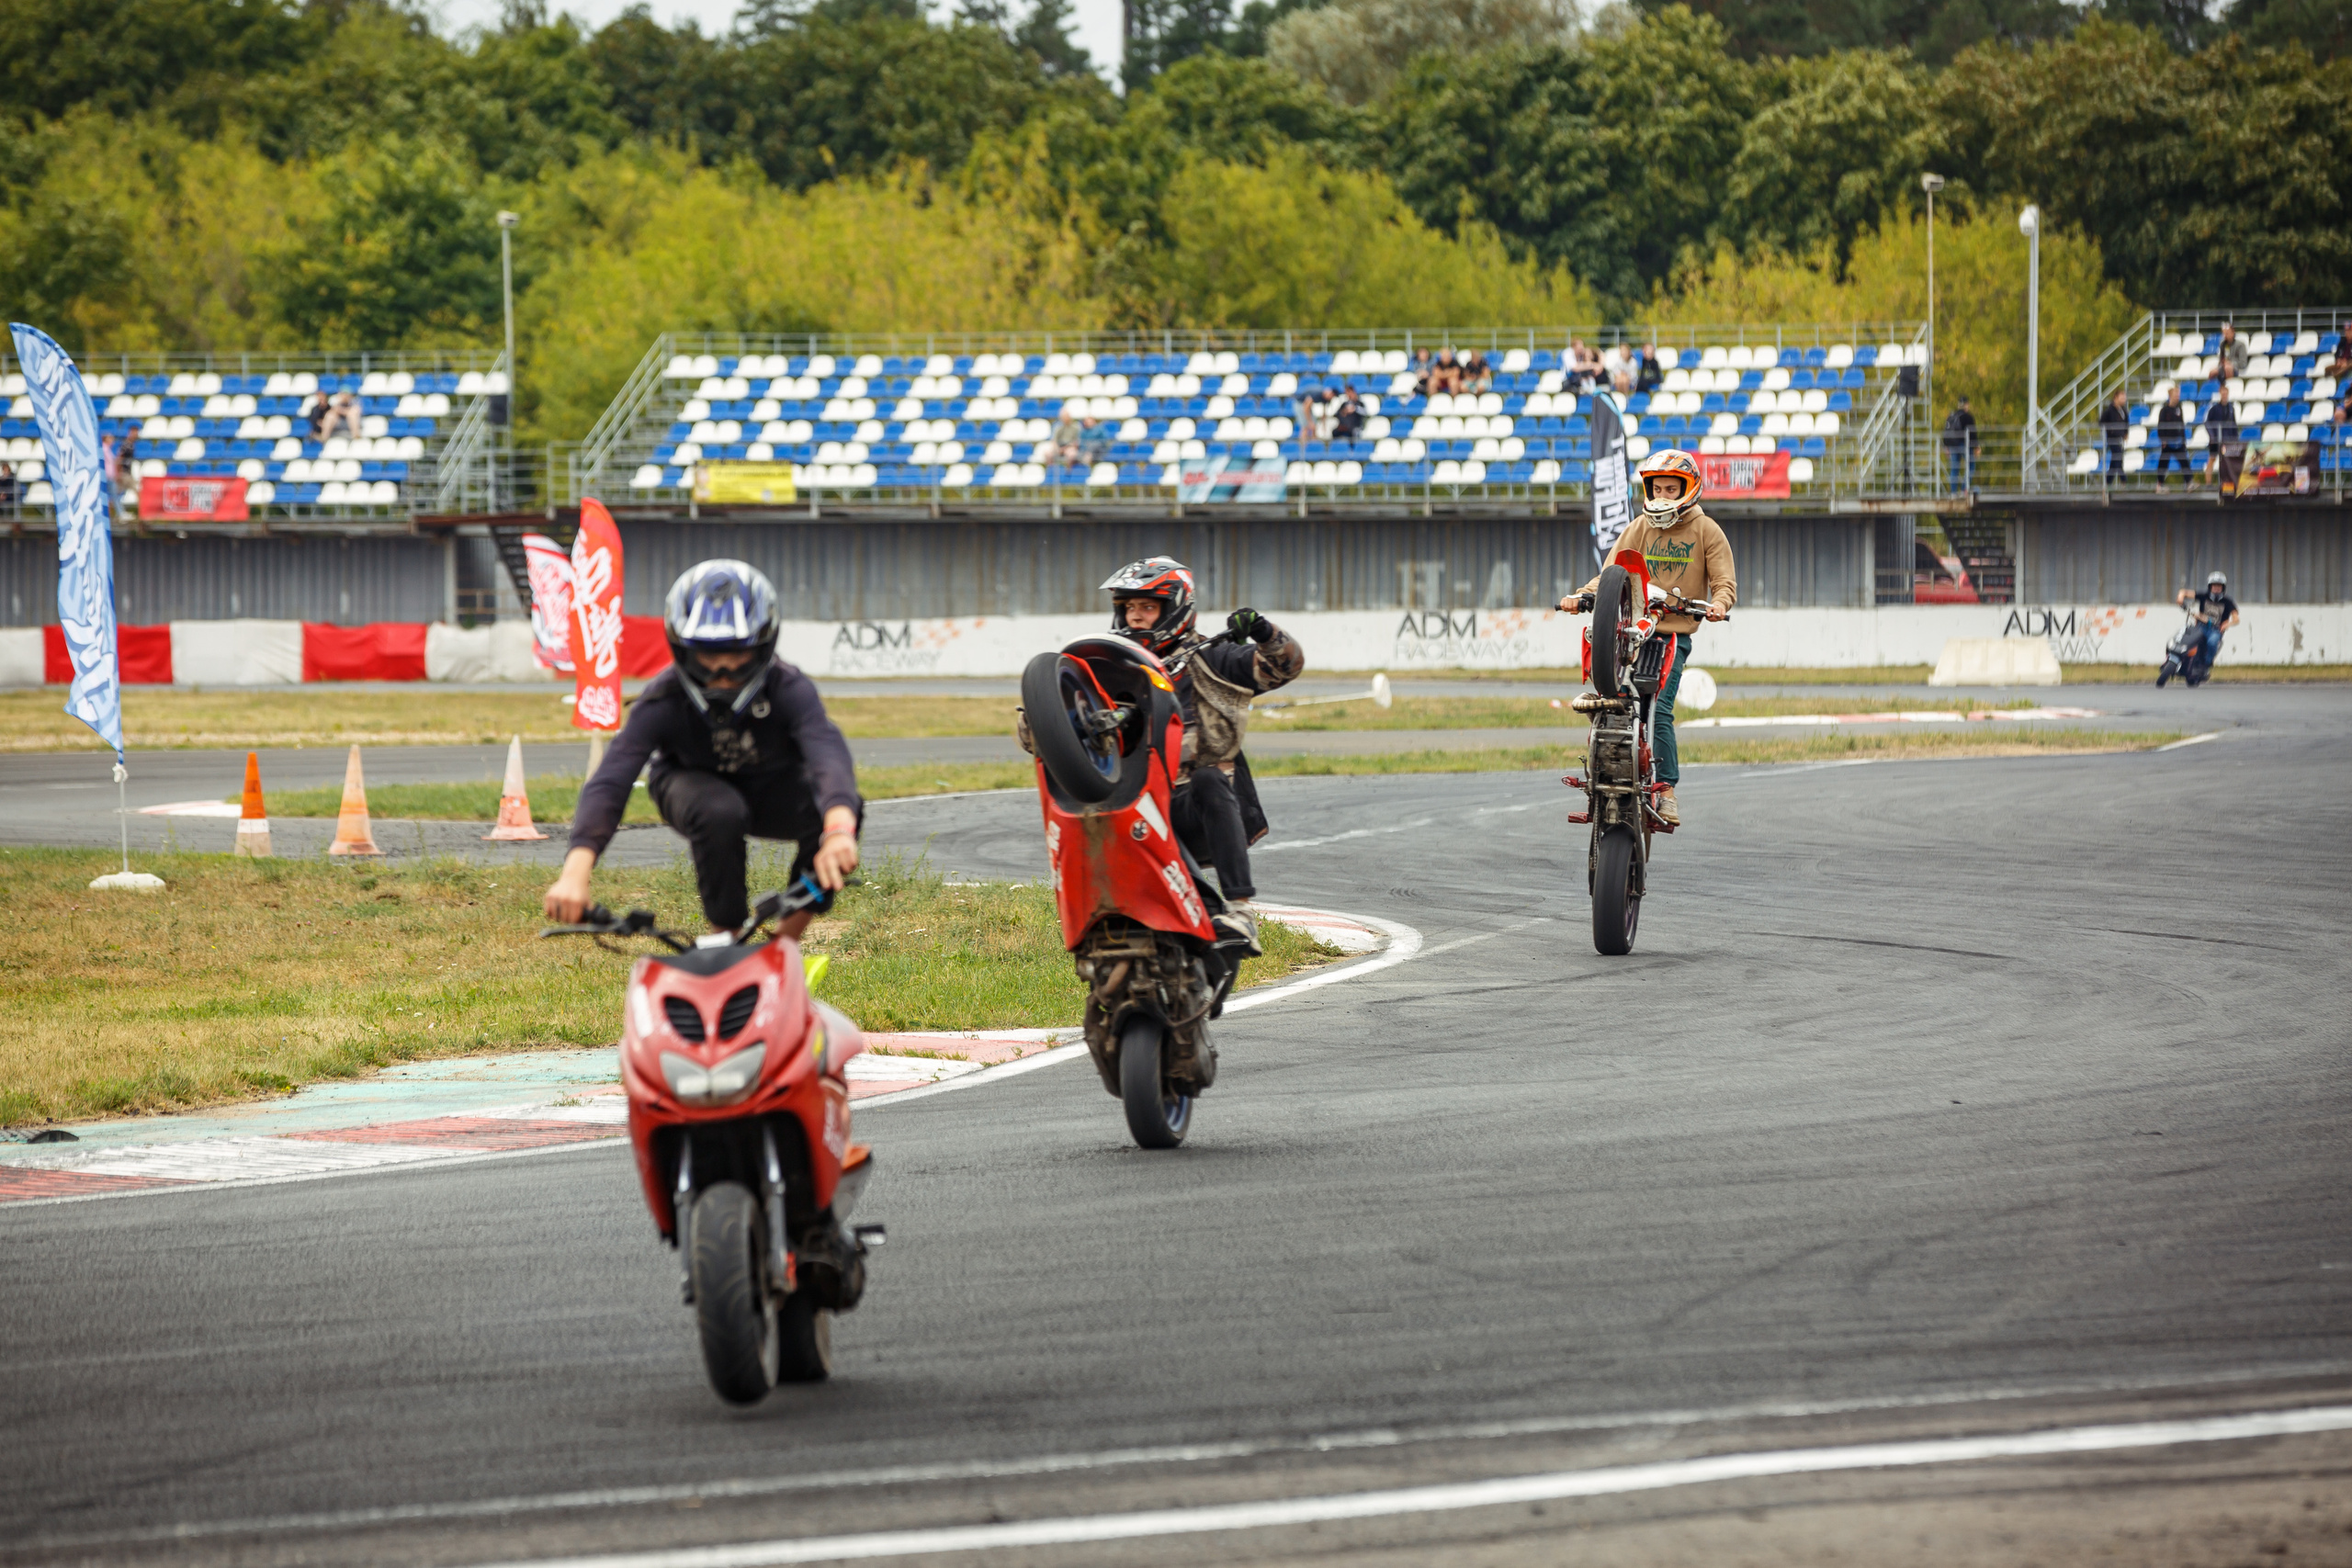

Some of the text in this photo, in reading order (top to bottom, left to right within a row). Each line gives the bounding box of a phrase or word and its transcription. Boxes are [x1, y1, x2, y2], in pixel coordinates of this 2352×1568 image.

[831, 621, 911, 650] ADM
[1396, 609, 1476, 639] ADM
[2003, 606, 2075, 637] ADM
[1395, 639, 1509, 660] RACEWAY
